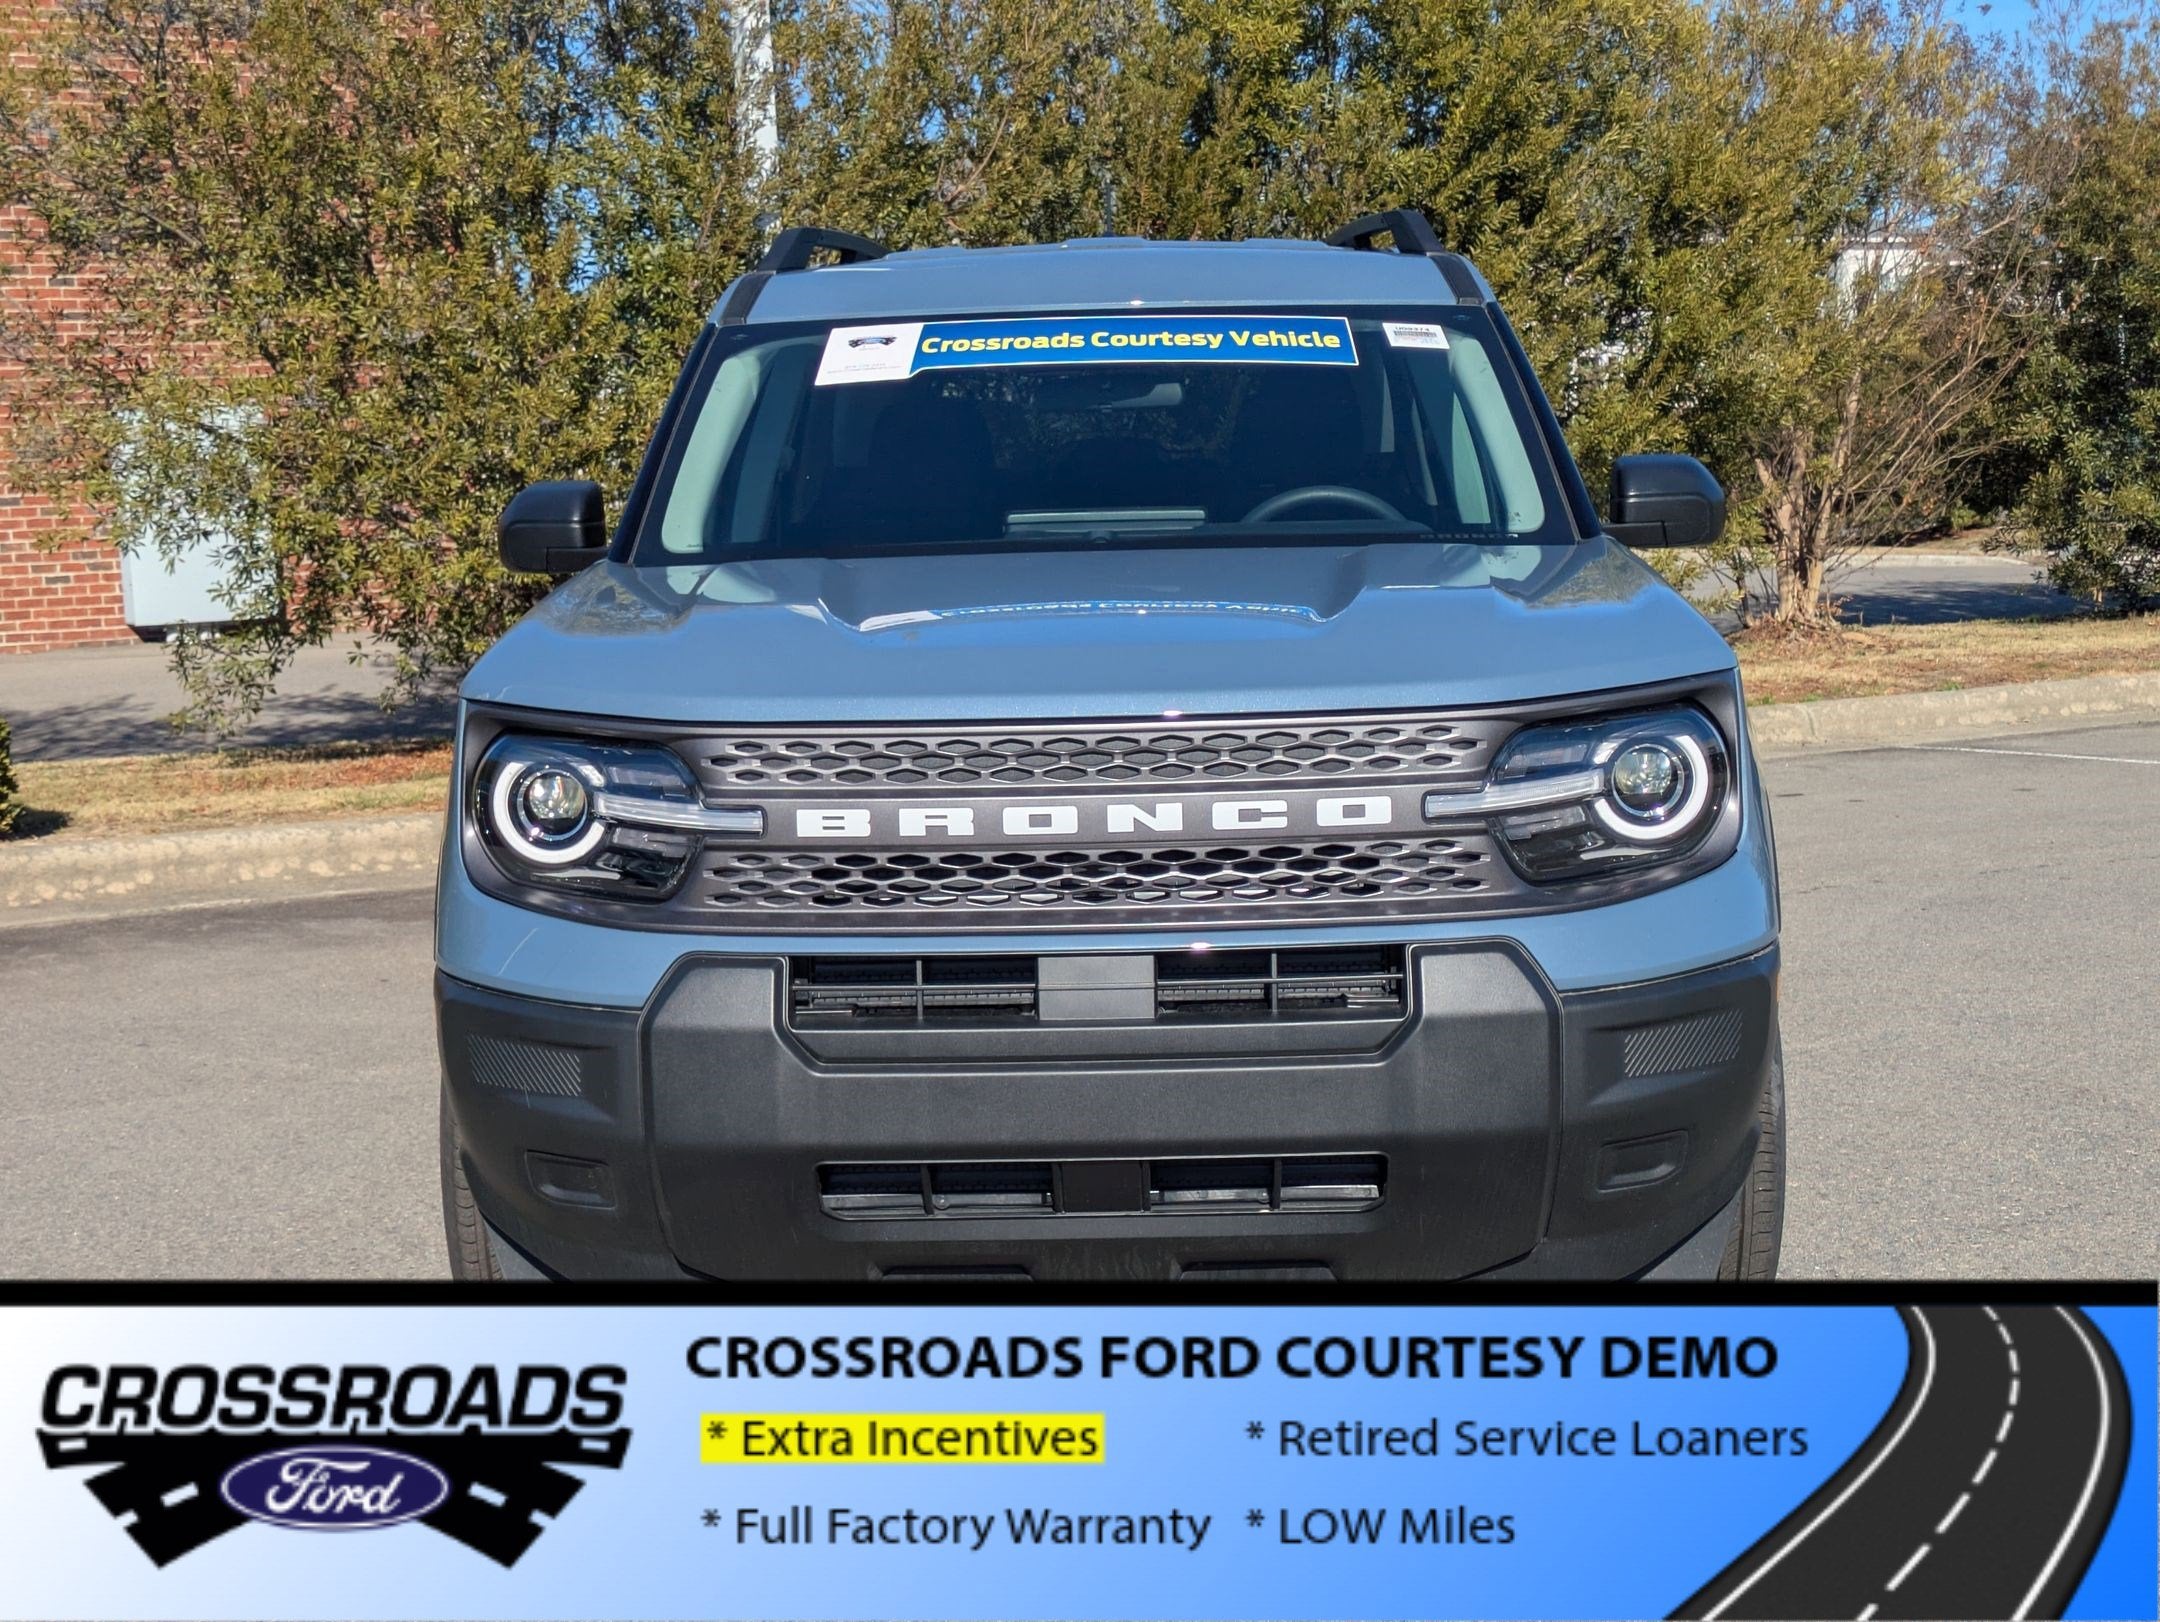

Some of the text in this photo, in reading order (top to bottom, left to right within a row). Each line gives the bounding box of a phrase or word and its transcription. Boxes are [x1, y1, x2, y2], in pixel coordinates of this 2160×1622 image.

[921, 330, 1341, 353] Crossroads Courtesy Vehicle
[796, 795, 1393, 838] BRONCO
